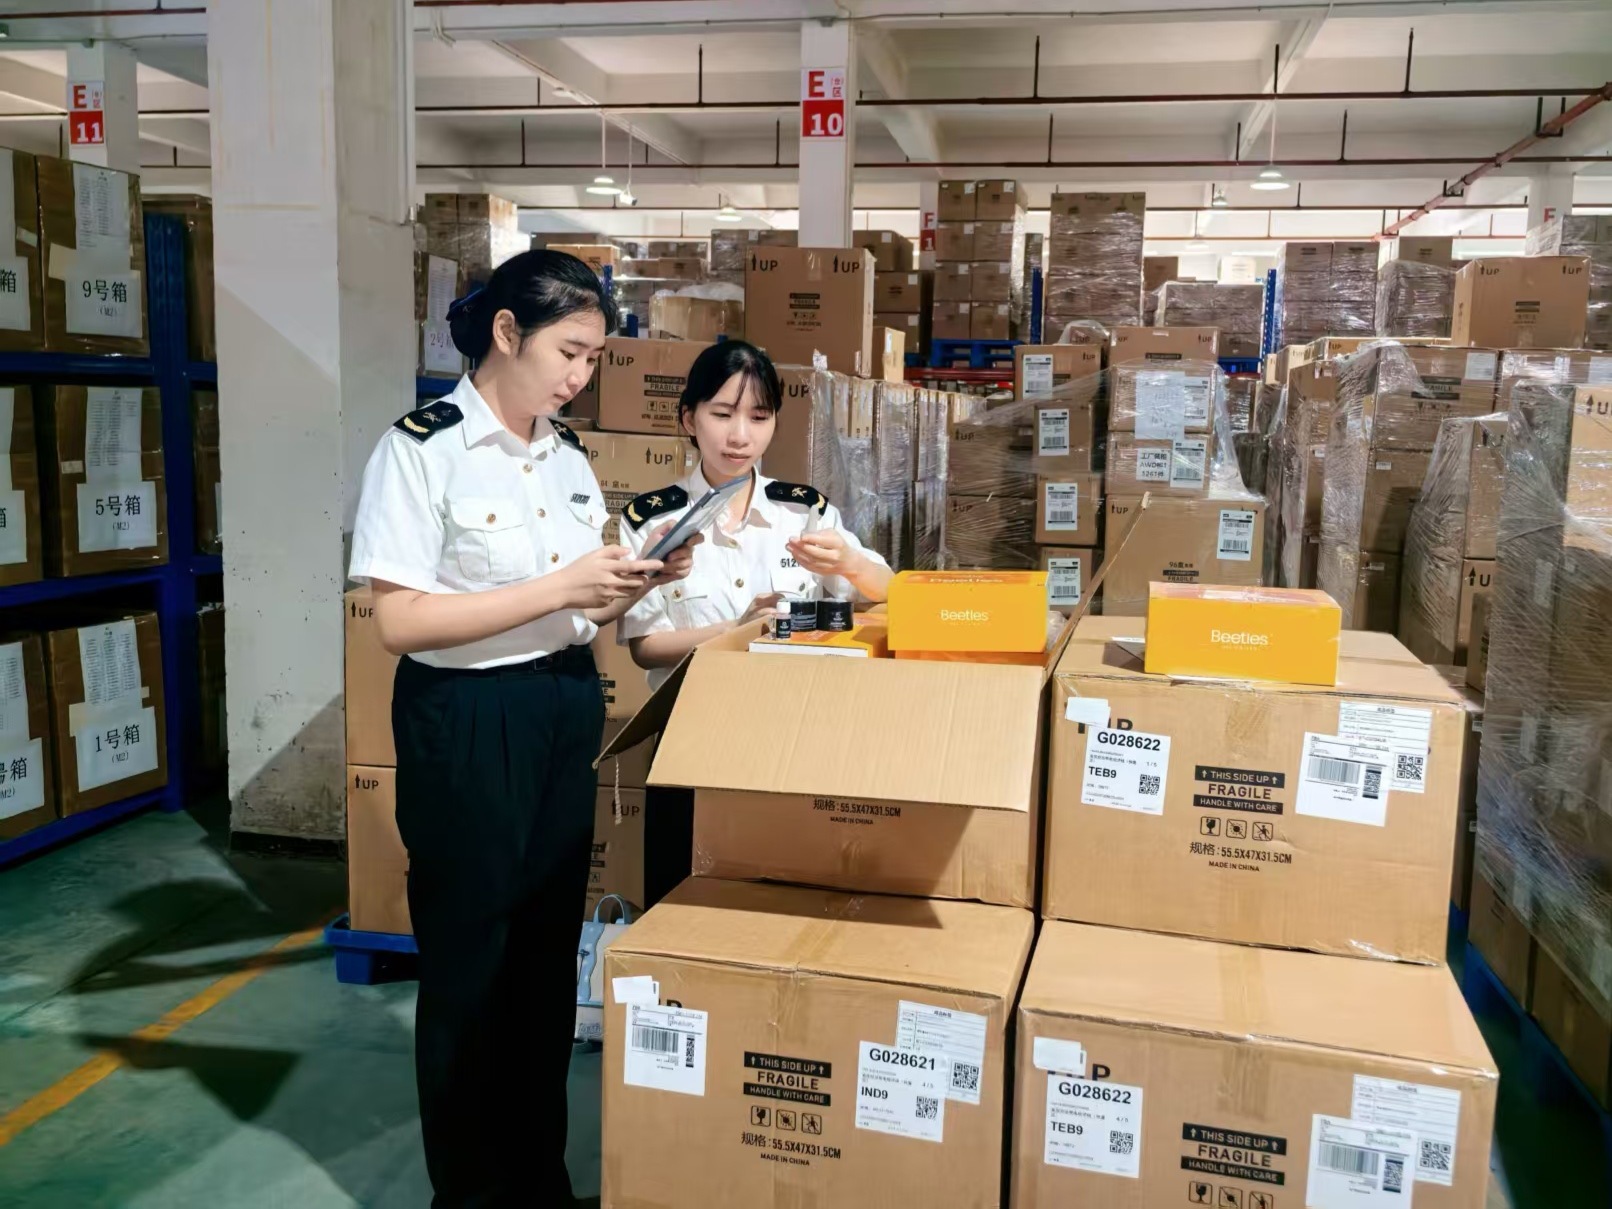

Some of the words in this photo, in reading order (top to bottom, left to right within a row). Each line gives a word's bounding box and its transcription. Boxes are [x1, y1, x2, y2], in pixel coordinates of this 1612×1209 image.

[808, 71, 825, 97] E
[73, 85, 87, 108] E
[77, 122, 102, 142] 11
[811, 113, 843, 135] 10
[924, 212, 935, 227] F
[760, 260, 778, 271] UP
[841, 262, 860, 273] UP
[1486, 267, 1499, 275] UP
[82, 280, 127, 303] 9号箱
[617, 356, 634, 367] UP
[789, 386, 809, 398] UP
[1598, 402, 1612, 416] U
[654, 454, 673, 465] UP
[95, 495, 141, 517] 5号箱
[1116, 506, 1129, 514] UP
[940, 609, 989, 621] Beetles
[1211, 629, 1269, 646] Beetles
[95, 724, 140, 752] 1号箱
[1097, 731, 1161, 751] G028622
[1088, 766, 1117, 779] TEB9
[1210, 770, 1231, 780] THIS
[1233, 773, 1255, 782] SIDE
[1256, 775, 1269, 784] UP
[363, 779, 379, 790] UP
[1208, 783, 1272, 800] FRAGILE
[621, 805, 640, 816] UP
[1200, 798, 1232, 808] HANDLE
[1233, 801, 1254, 809] WITH
[1255, 803, 1277, 812] CARE
[1208, 860, 1227, 868] MADE
[1238, 863, 1260, 872] CHINA
[759, 1057, 780, 1068] THIS
[781, 1060, 802, 1071] SIDE
[803, 1064, 816, 1073] UP
[869, 1047, 935, 1071] G028621
[757, 1071, 819, 1090] FRAGILE
[750, 1086, 781, 1098] HANDLE
[782, 1090, 802, 1100] WITH
[803, 1093, 825, 1103] CARE
[861, 1086, 888, 1099] IND9
[1058, 1081, 1132, 1105] G028622
[1050, 1120, 1083, 1136] TEB9
[1200, 1129, 1225, 1143] THIS
[1226, 1134, 1251, 1147] SIDE
[1253, 1138, 1268, 1150] UP
[760, 1153, 779, 1162] MADE
[780, 1155, 788, 1163] IN
[789, 1157, 810, 1167] CHINA
[1198, 1144, 1271, 1168] FRAGILE
[1188, 1159, 1226, 1174] HANDLE
[1227, 1165, 1250, 1178] WITH
[1251, 1170, 1278, 1182] CARE
